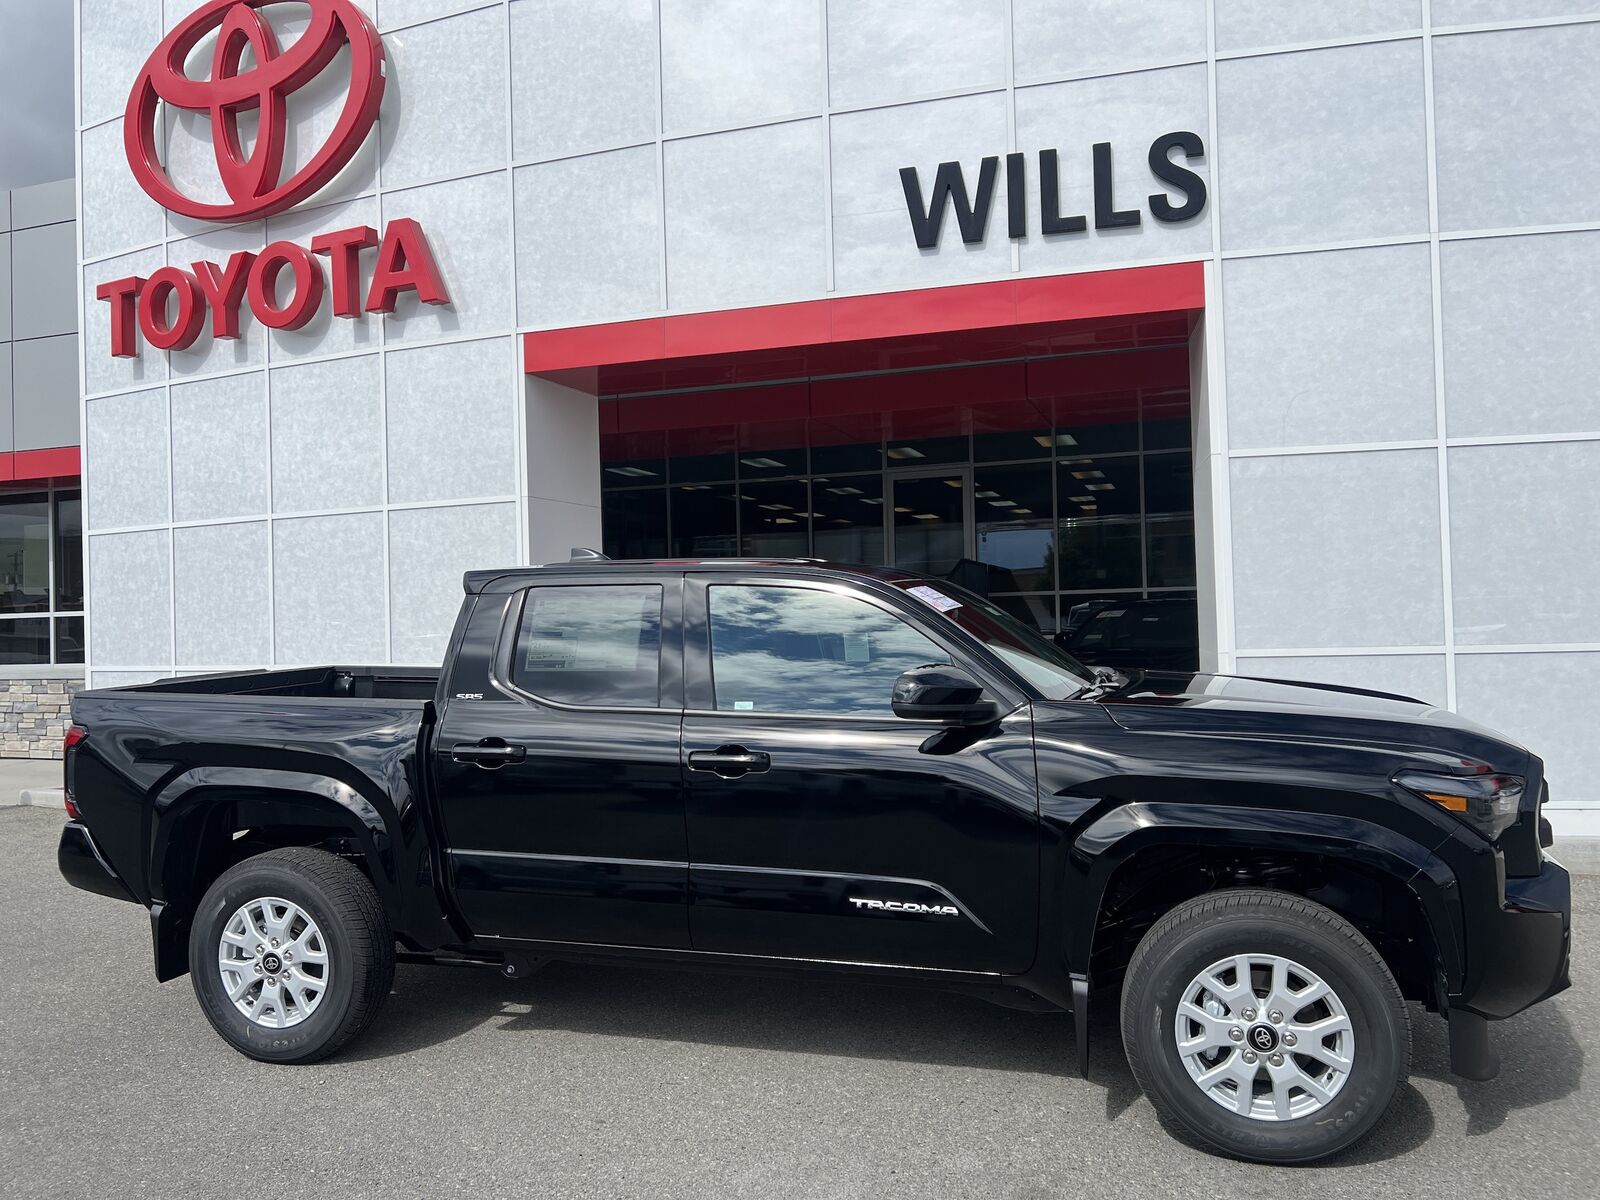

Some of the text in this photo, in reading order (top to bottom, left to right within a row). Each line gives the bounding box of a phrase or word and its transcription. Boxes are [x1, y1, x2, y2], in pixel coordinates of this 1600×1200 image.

[898, 131, 1207, 248] WILLS
[97, 217, 450, 358] TOYOTA
[455, 693, 484, 701] SR5
[848, 897, 960, 916] TACOMA
